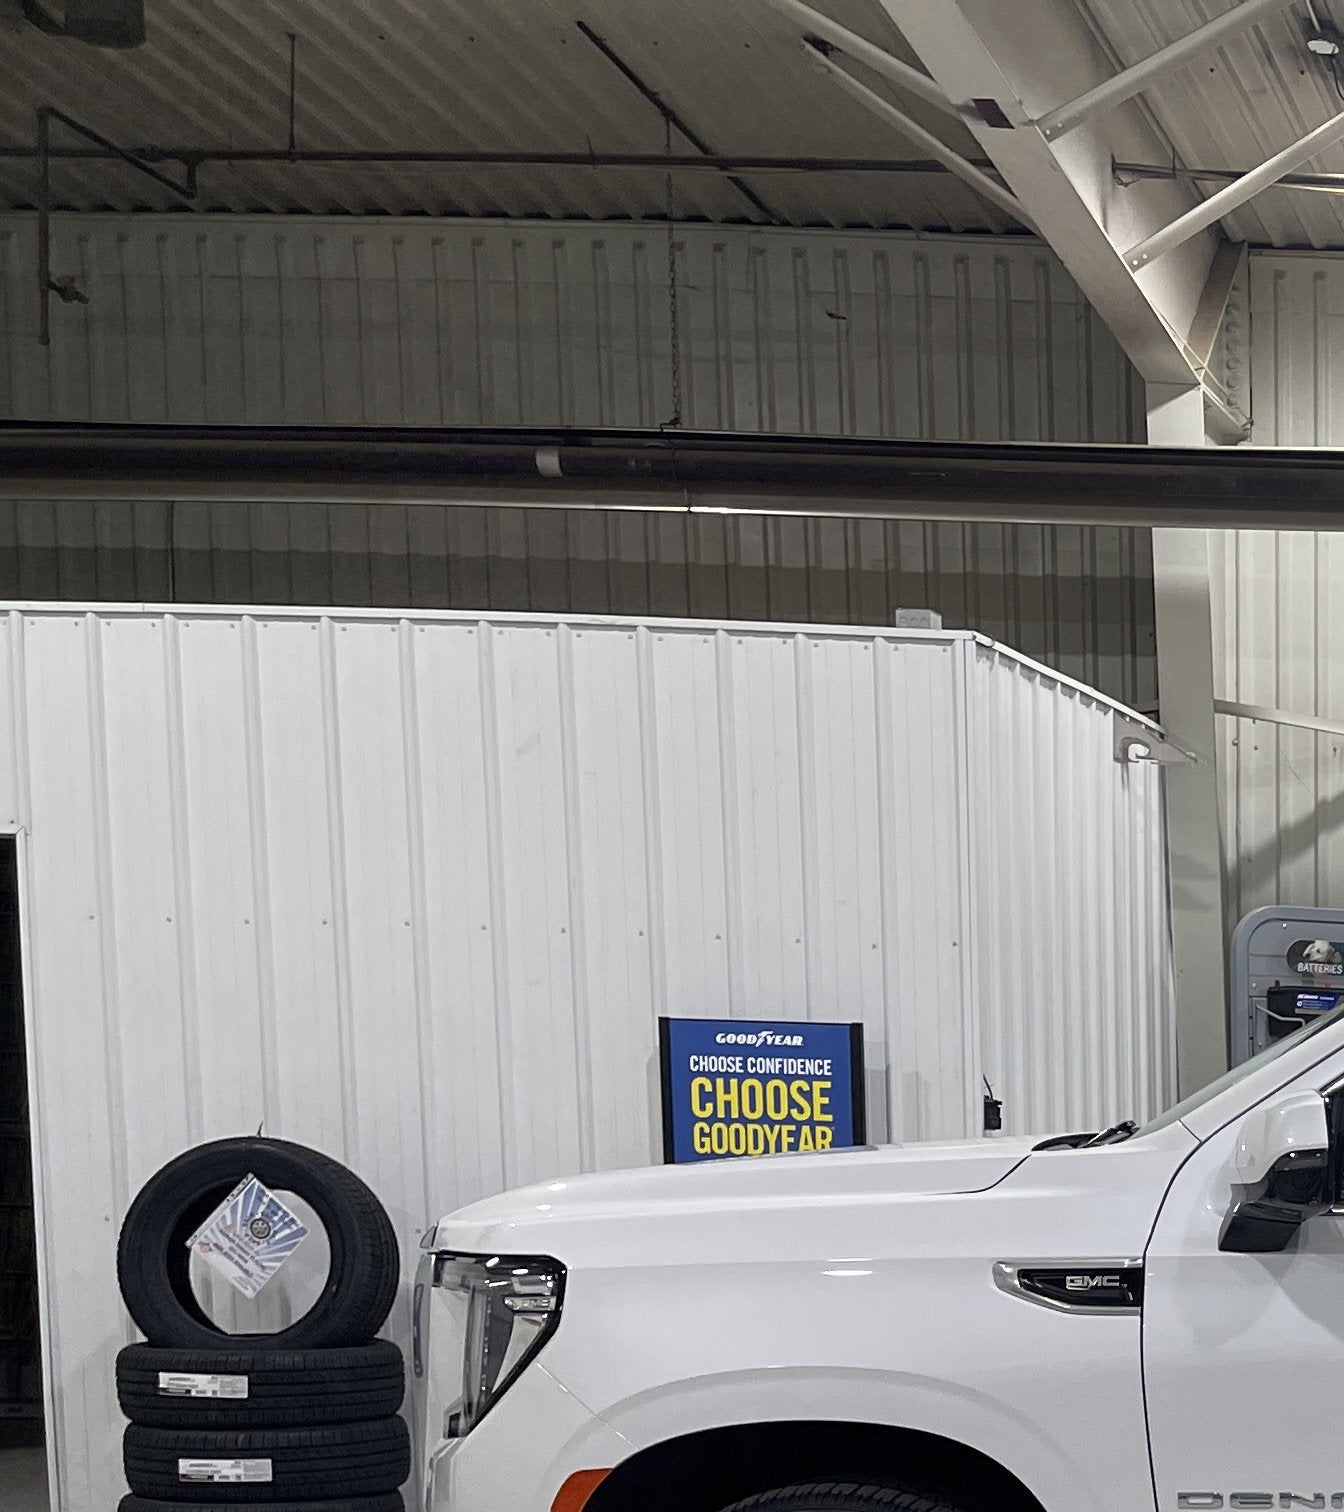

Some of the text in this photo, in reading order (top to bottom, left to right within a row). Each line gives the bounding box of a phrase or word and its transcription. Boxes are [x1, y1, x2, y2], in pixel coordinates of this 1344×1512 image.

[1297, 962, 1343, 975] BATTERIES
[715, 1030, 804, 1048] GOODYEAR
[689, 1055, 833, 1076] CHOOSE CONFIDENCE
[690, 1076, 834, 1122] CHOOSE
[1066, 1275, 1120, 1288] GMC
